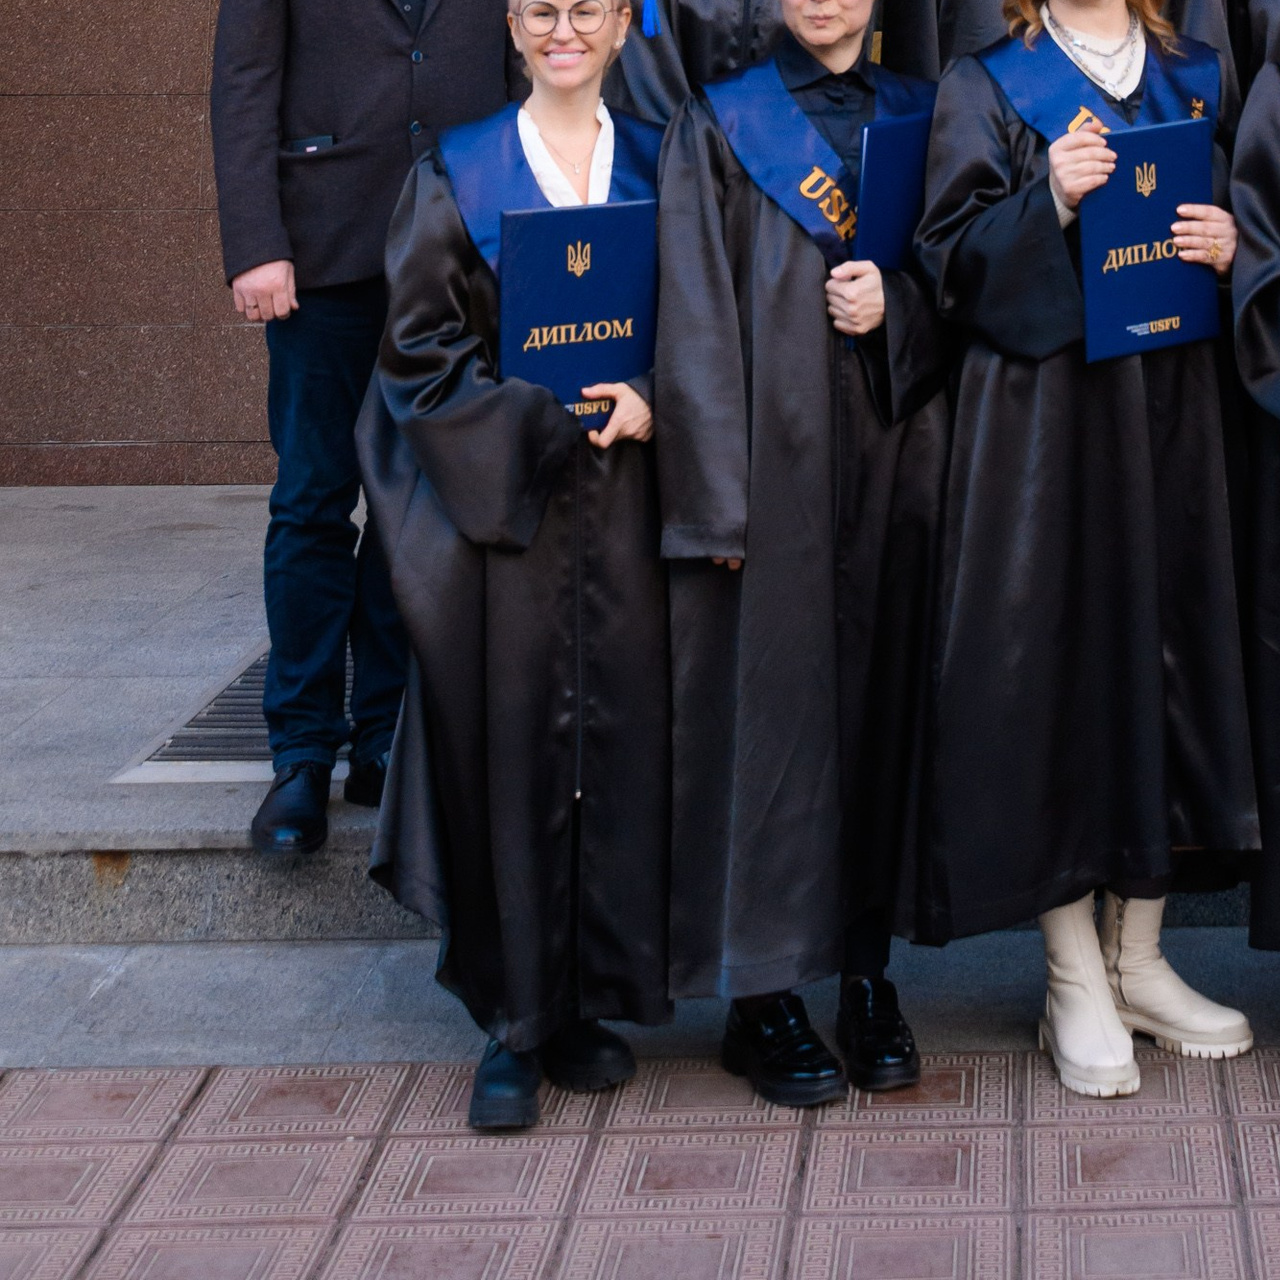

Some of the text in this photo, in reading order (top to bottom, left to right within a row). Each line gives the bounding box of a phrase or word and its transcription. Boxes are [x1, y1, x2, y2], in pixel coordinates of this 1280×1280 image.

[1102, 238, 1181, 275] ДИПЛО
[523, 318, 633, 352] ДИПЛОМ
[1149, 315, 1181, 334] USFU
[574, 400, 610, 416] USFU
